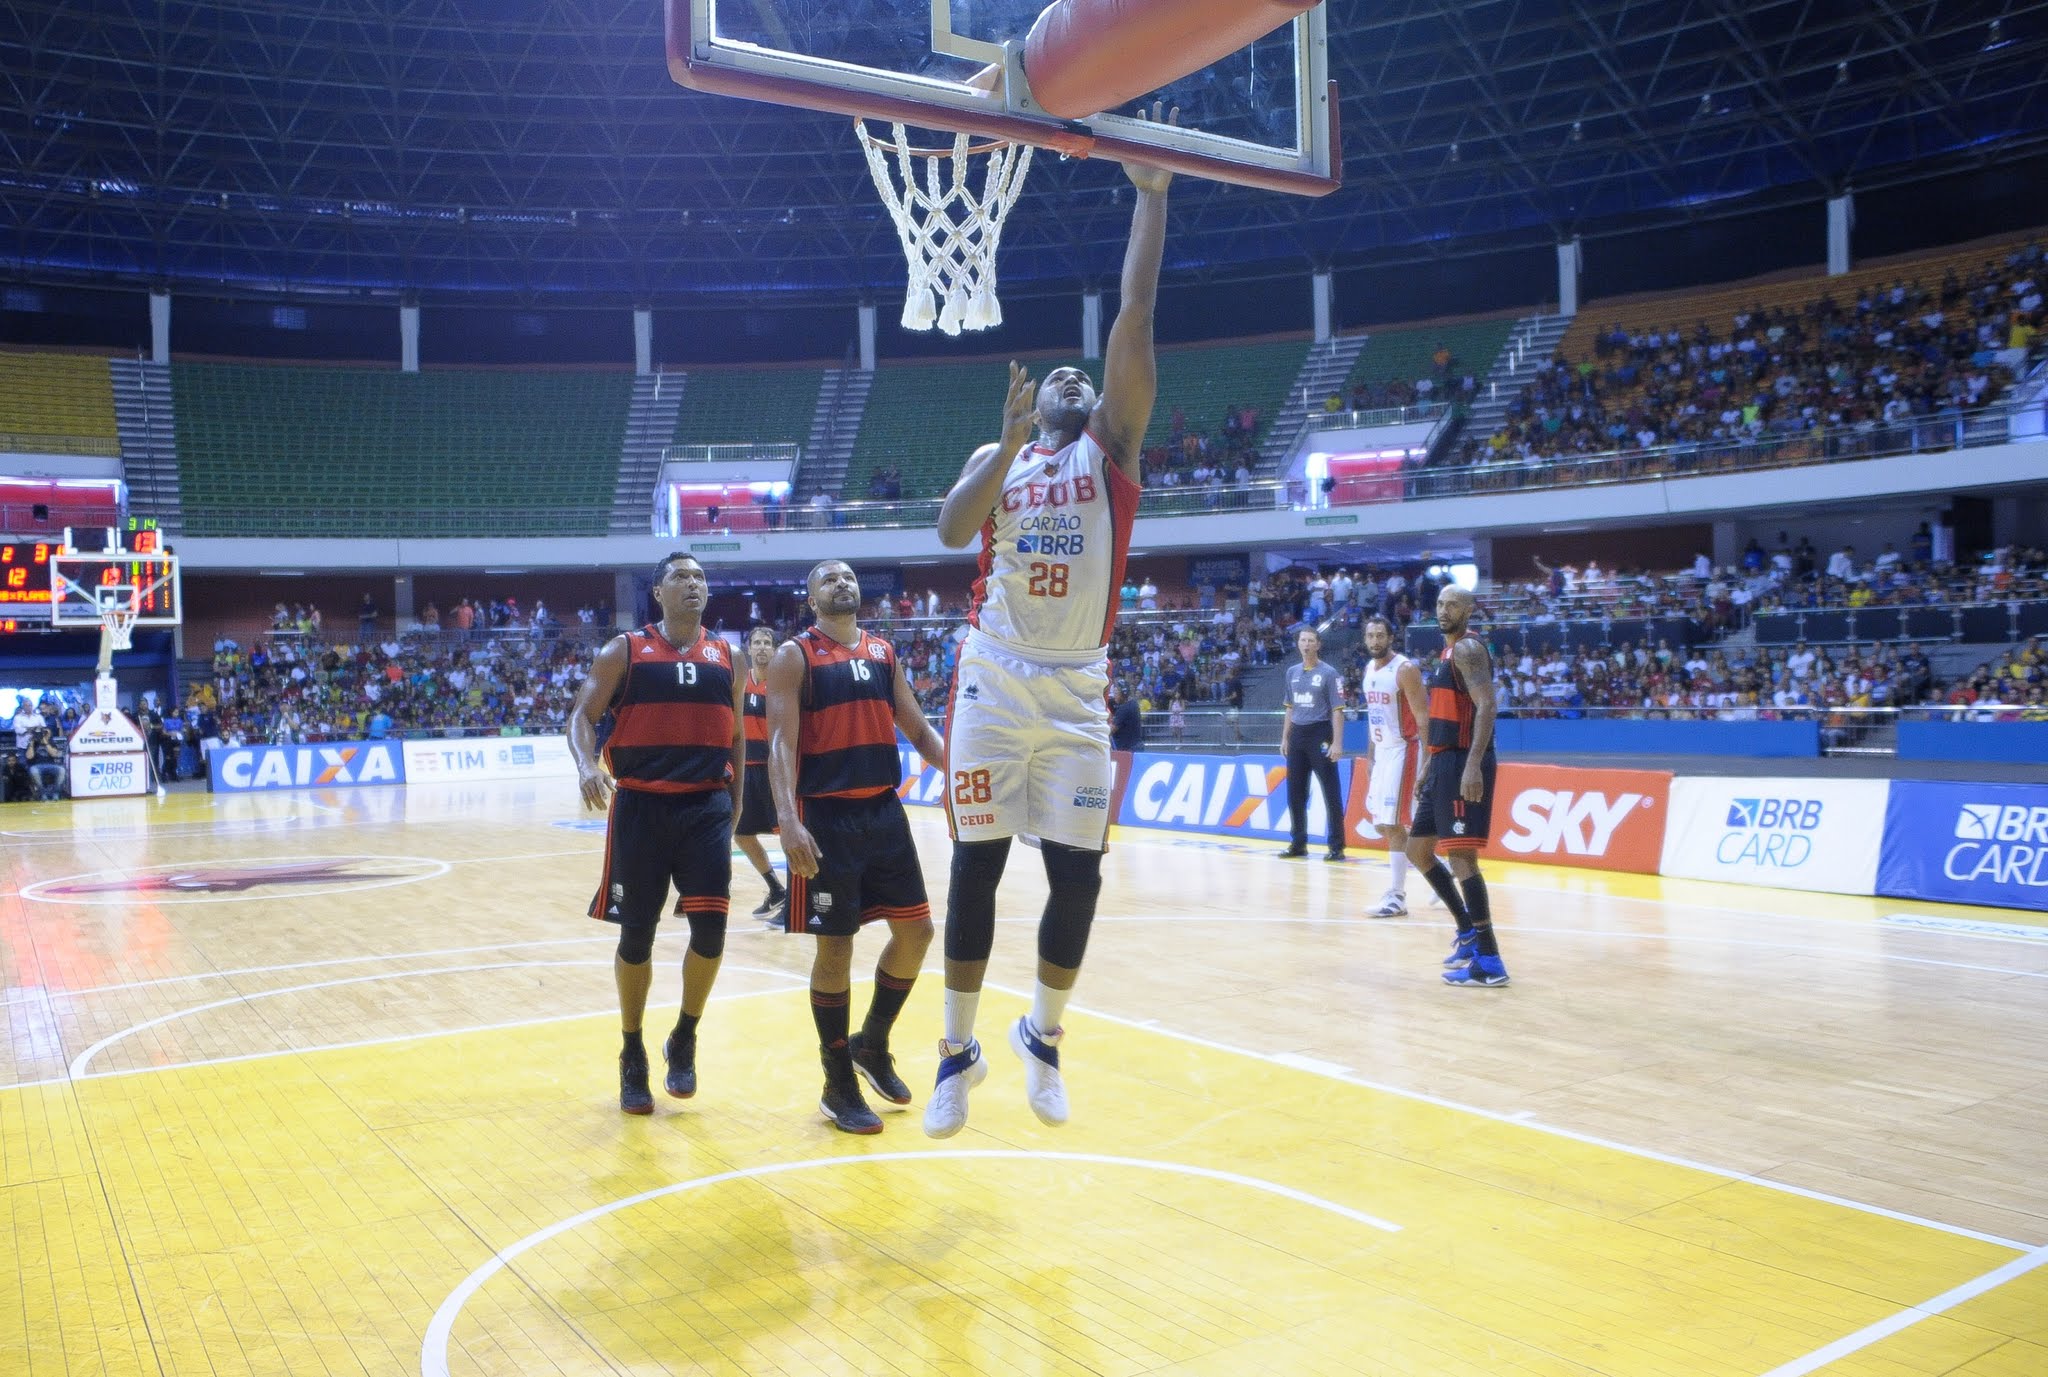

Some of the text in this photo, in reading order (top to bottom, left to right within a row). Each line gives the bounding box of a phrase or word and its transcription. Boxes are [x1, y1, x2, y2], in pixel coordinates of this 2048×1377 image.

[1001, 474, 1098, 513] CEUB
[129, 518, 156, 530] 3 14
[1020, 514, 1081, 531] CARTÃO
[2, 546, 14, 562] 2
[34, 543, 48, 563] 3
[1040, 534, 1084, 555] BRB
[8, 568, 27, 586] 12
[1028, 562, 1070, 598] 28
[676, 662, 697, 684] 13
[849, 659, 871, 681] 16
[749, 693, 758, 707] 4
[105, 762, 133, 775] BRB
[221, 746, 396, 788] CAIXA
[442, 750, 485, 769] TIM
[88, 775, 132, 791] CARD
[955, 769, 992, 804] 28
[1086, 797, 1107, 809] BRB
[960, 814, 995, 826] CEUB
[1501, 788, 1643, 856] SKY
[1759, 799, 1823, 830] BRB
[1717, 832, 1812, 867] CARD
